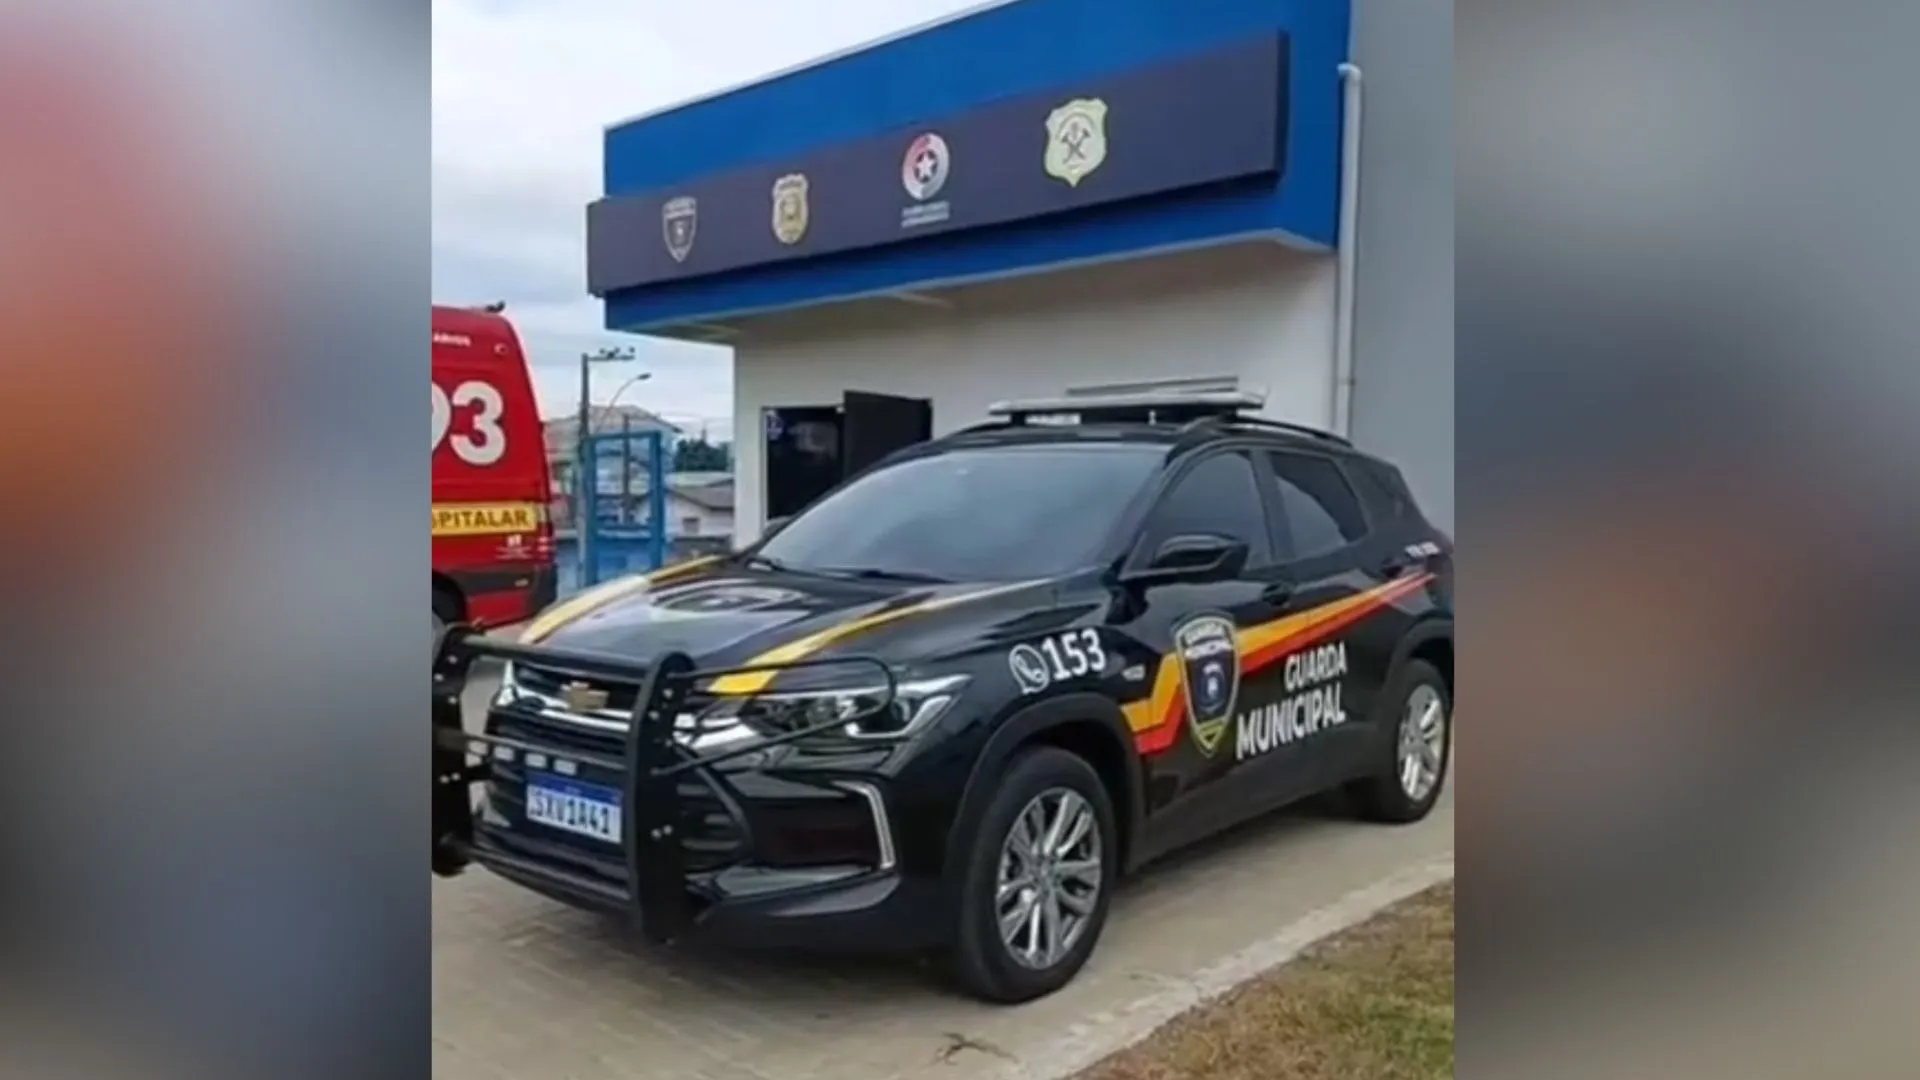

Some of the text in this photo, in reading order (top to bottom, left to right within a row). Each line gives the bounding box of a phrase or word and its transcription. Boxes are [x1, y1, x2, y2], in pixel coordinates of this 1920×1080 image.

[1042, 628, 1106, 680] 153
[1284, 640, 1347, 691] GUARDA
[1236, 681, 1347, 760] MUNICIPAL
